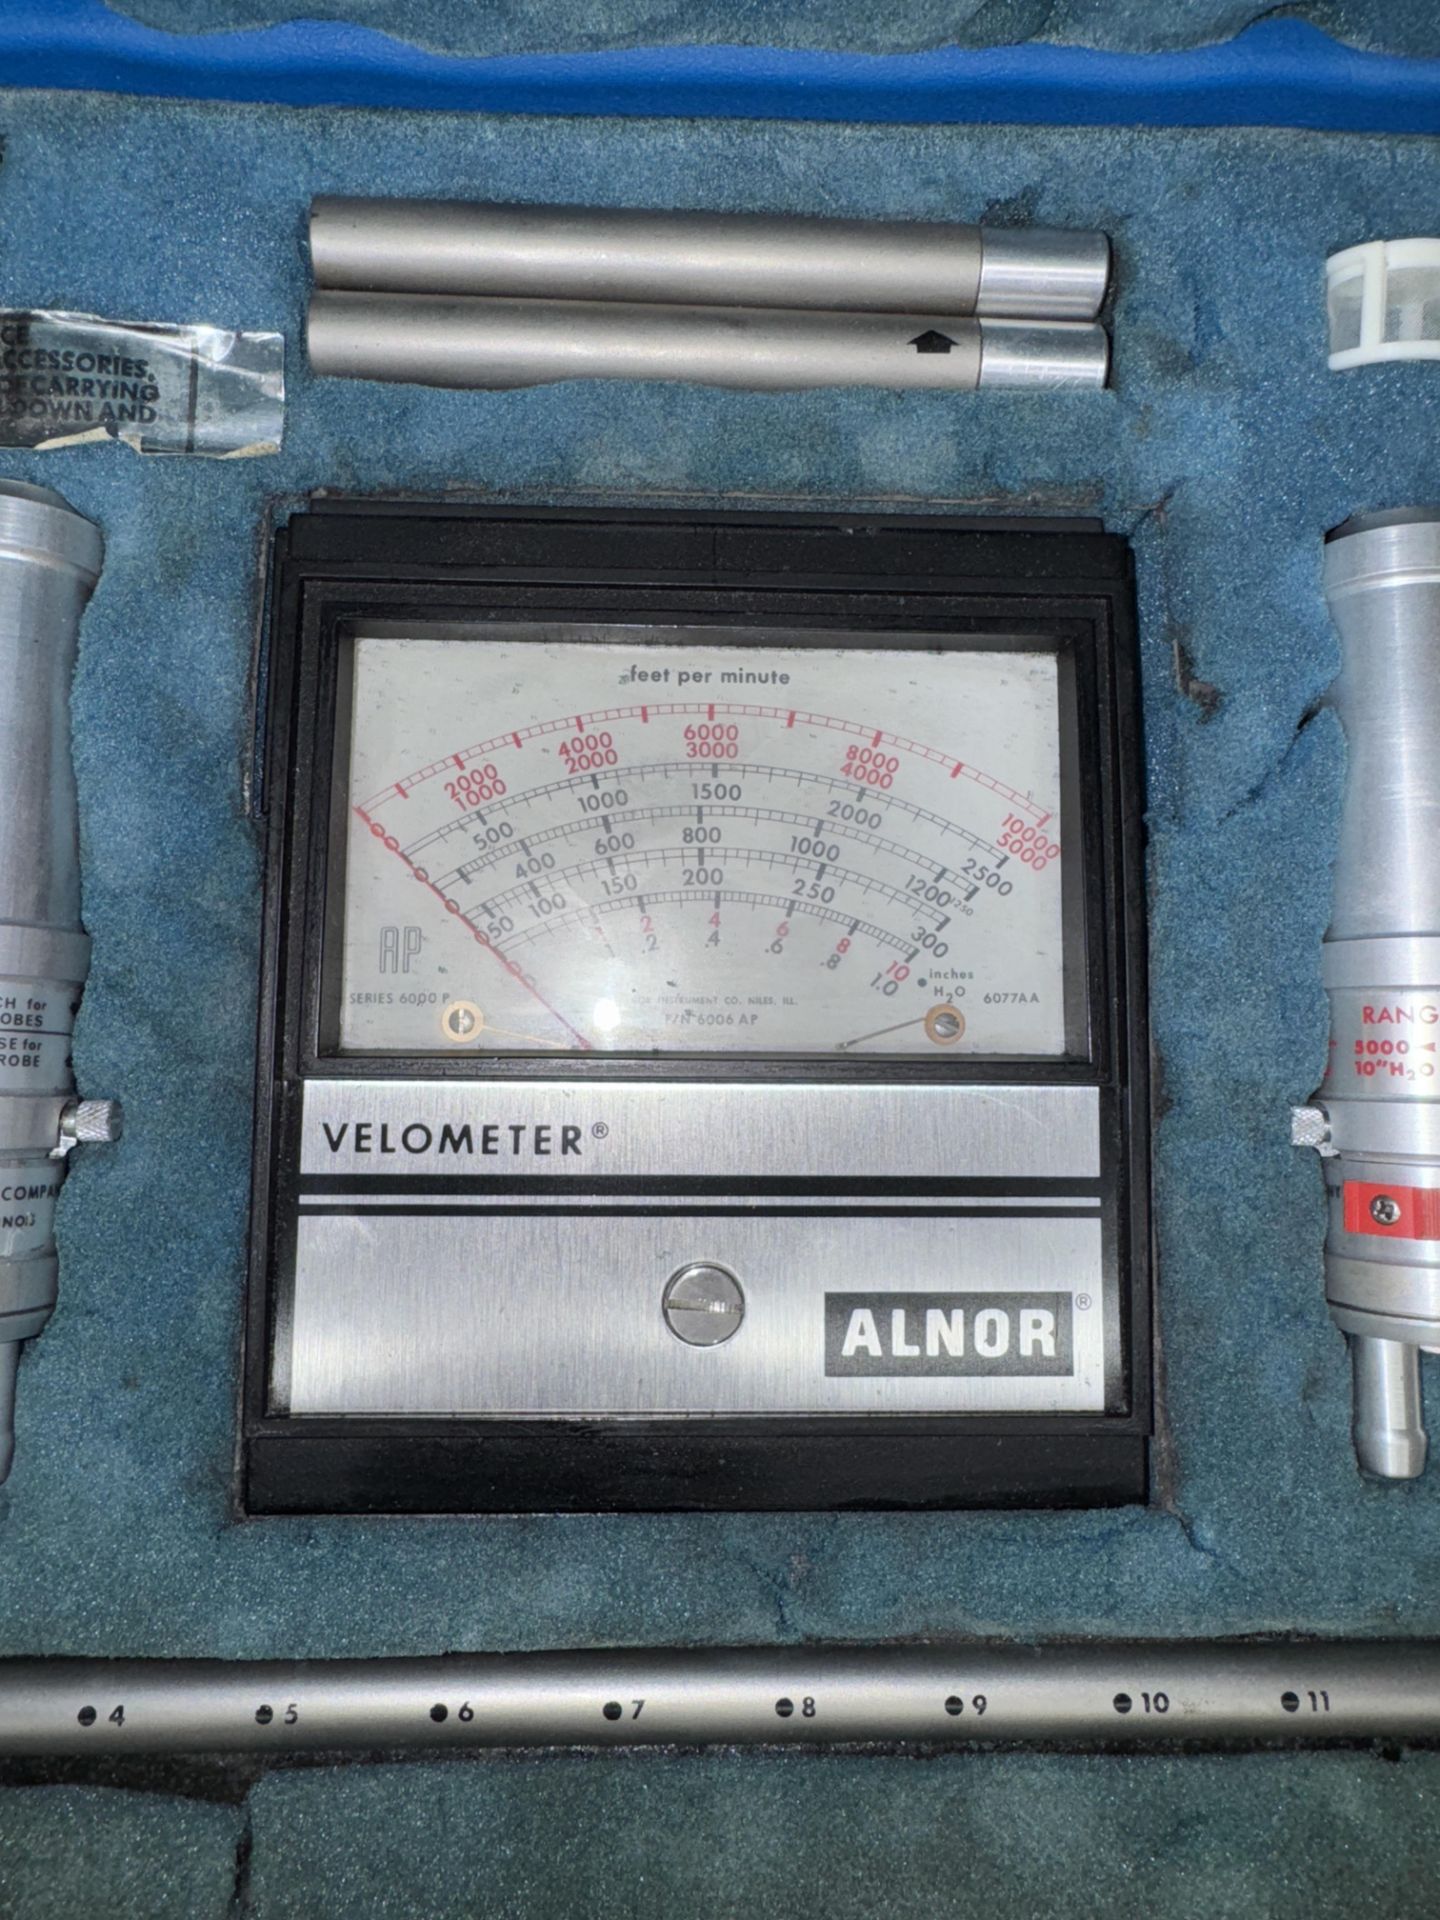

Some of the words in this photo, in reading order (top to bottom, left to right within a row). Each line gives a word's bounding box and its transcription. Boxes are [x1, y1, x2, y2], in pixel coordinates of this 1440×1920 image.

[31, 375, 160, 402] CARRYING
[98, 402, 157, 424] AND
[630, 665, 670, 682] feet
[678, 671, 712, 686] per
[721, 667, 790, 684] minute
[558, 732, 612, 756] 4000
[683, 724, 739, 741] 6000
[564, 749, 618, 774] 2000
[686, 742, 739, 758] 3000
[846, 745, 899, 773] 8000
[444, 764, 498, 799] 2000
[840, 762, 893, 790] 4000
[454, 779, 507, 812] 1000
[578, 789, 629, 813] 1000
[691, 783, 742, 801] 1500
[827, 800, 882, 830] 2000
[472, 821, 514, 851] 500
[594, 832, 635, 855] 600
[682, 826, 722, 844] 800
[1001, 812, 1061, 860] 10000
[790, 835, 840, 862] 1000
[996, 832, 1047, 871] 5000
[515, 852, 556, 879] 400
[682, 868, 724, 886] 200
[601, 873, 638, 897] 150
[960, 858, 1013, 897] 2500
[792, 878, 835, 904] 250
[904, 874, 952, 908] 1200
[528, 893, 566, 918] 100
[487, 915, 514, 940] 50
[640, 915, 655, 933] 2
[708, 911, 721, 928] 4
[776, 921, 790, 938] 6
[379, 926, 422, 973] AP
[641, 934, 660, 954] .2
[705, 930, 721, 948] .4
[764, 938, 783, 954] .6
[836, 937, 851, 955] 8
[910, 926, 948, 959] 300
[821, 954, 841, 971] .8
[886, 960, 910, 982] 10
[929, 968, 974, 980] inches
[870, 972, 899, 998] 1.0
[27, 998, 48, 1011] for
[349, 992, 393, 1005] SERIES
[399, 992, 437, 1006] 6000
[724, 996, 743, 1006] CO.
[984, 992, 1040, 1005] 6077AA
[698, 1014, 734, 1026] 6006
[739, 1014, 759, 1026] AP
[23, 1038, 43, 1052] for
[322, 1122, 583, 1156] VELOMETER
[840, 1307, 1058, 1358] ALNOR
[457, 1700, 475, 1723] 6
[630, 1699, 645, 1721] 7
[801, 1696, 817, 1718] 8
[971, 1694, 988, 1716] 9
[1141, 1692, 1170, 1715] 10
[1306, 1690, 1331, 1713] 11
[108, 1704, 126, 1727] 4
[284, 1703, 299, 1726] 5
